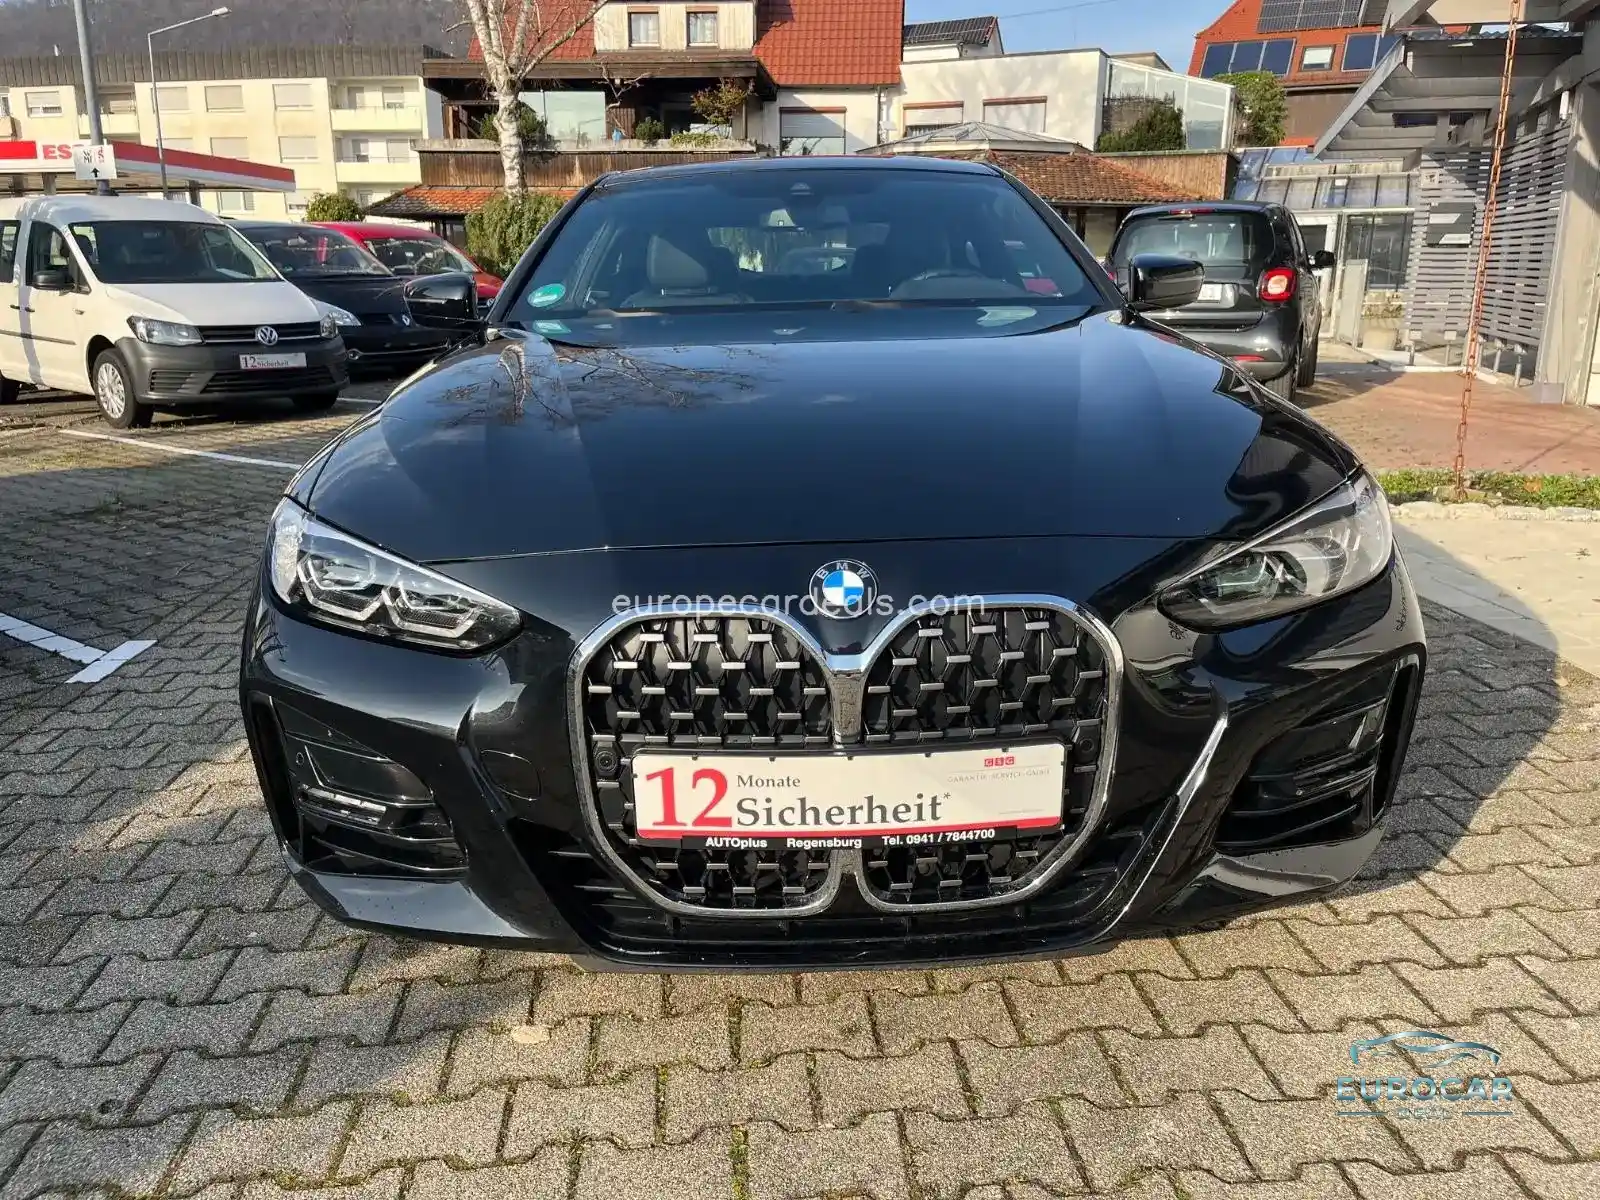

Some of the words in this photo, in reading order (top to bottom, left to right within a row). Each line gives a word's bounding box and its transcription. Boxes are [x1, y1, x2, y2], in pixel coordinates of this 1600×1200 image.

[241, 355, 257, 369] 12
[815, 562, 870, 580] BMW
[736, 774, 801, 789] Monate
[645, 766, 733, 828] 12
[705, 836, 768, 850] AUTOplus
[786, 837, 862, 851] Regensburg
[882, 835, 903, 847] Tel.
[906, 833, 934, 845] 0941
[946, 828, 996, 843] 7844700
